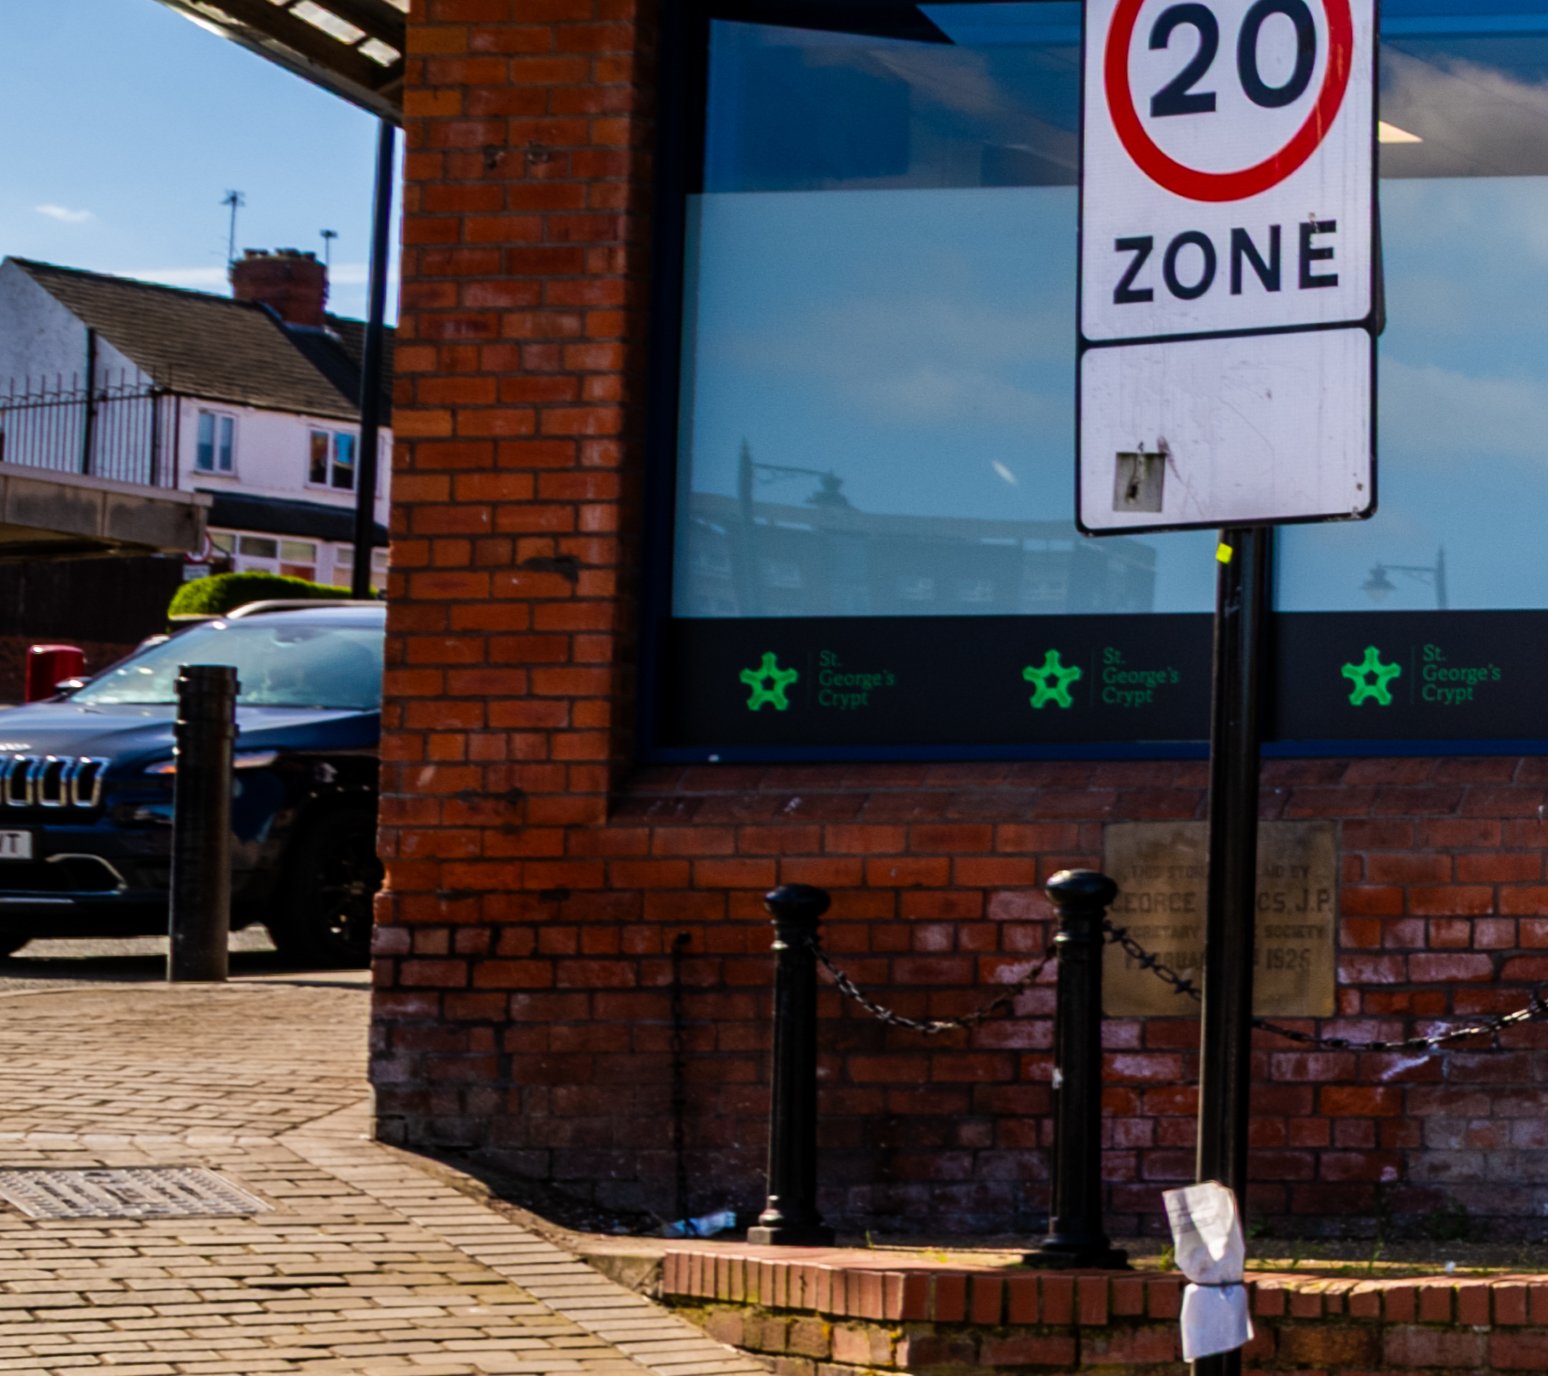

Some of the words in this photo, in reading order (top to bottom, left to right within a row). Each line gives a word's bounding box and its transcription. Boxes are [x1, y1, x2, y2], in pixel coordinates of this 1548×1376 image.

[1113, 219, 1339, 305] ZONE
[818, 651, 843, 668] St.
[1104, 647, 1127, 664] St.
[1424, 644, 1446, 662] St.
[818, 669, 896, 691] George's
[1103, 666, 1180, 688] George's
[1423, 663, 1502, 685] George's
[817, 690, 870, 710] Crypt
[1102, 687, 1153, 709] Crypt
[1422, 683, 1474, 705] Crypt
[1263, 924, 1325, 939] SOCIETY
